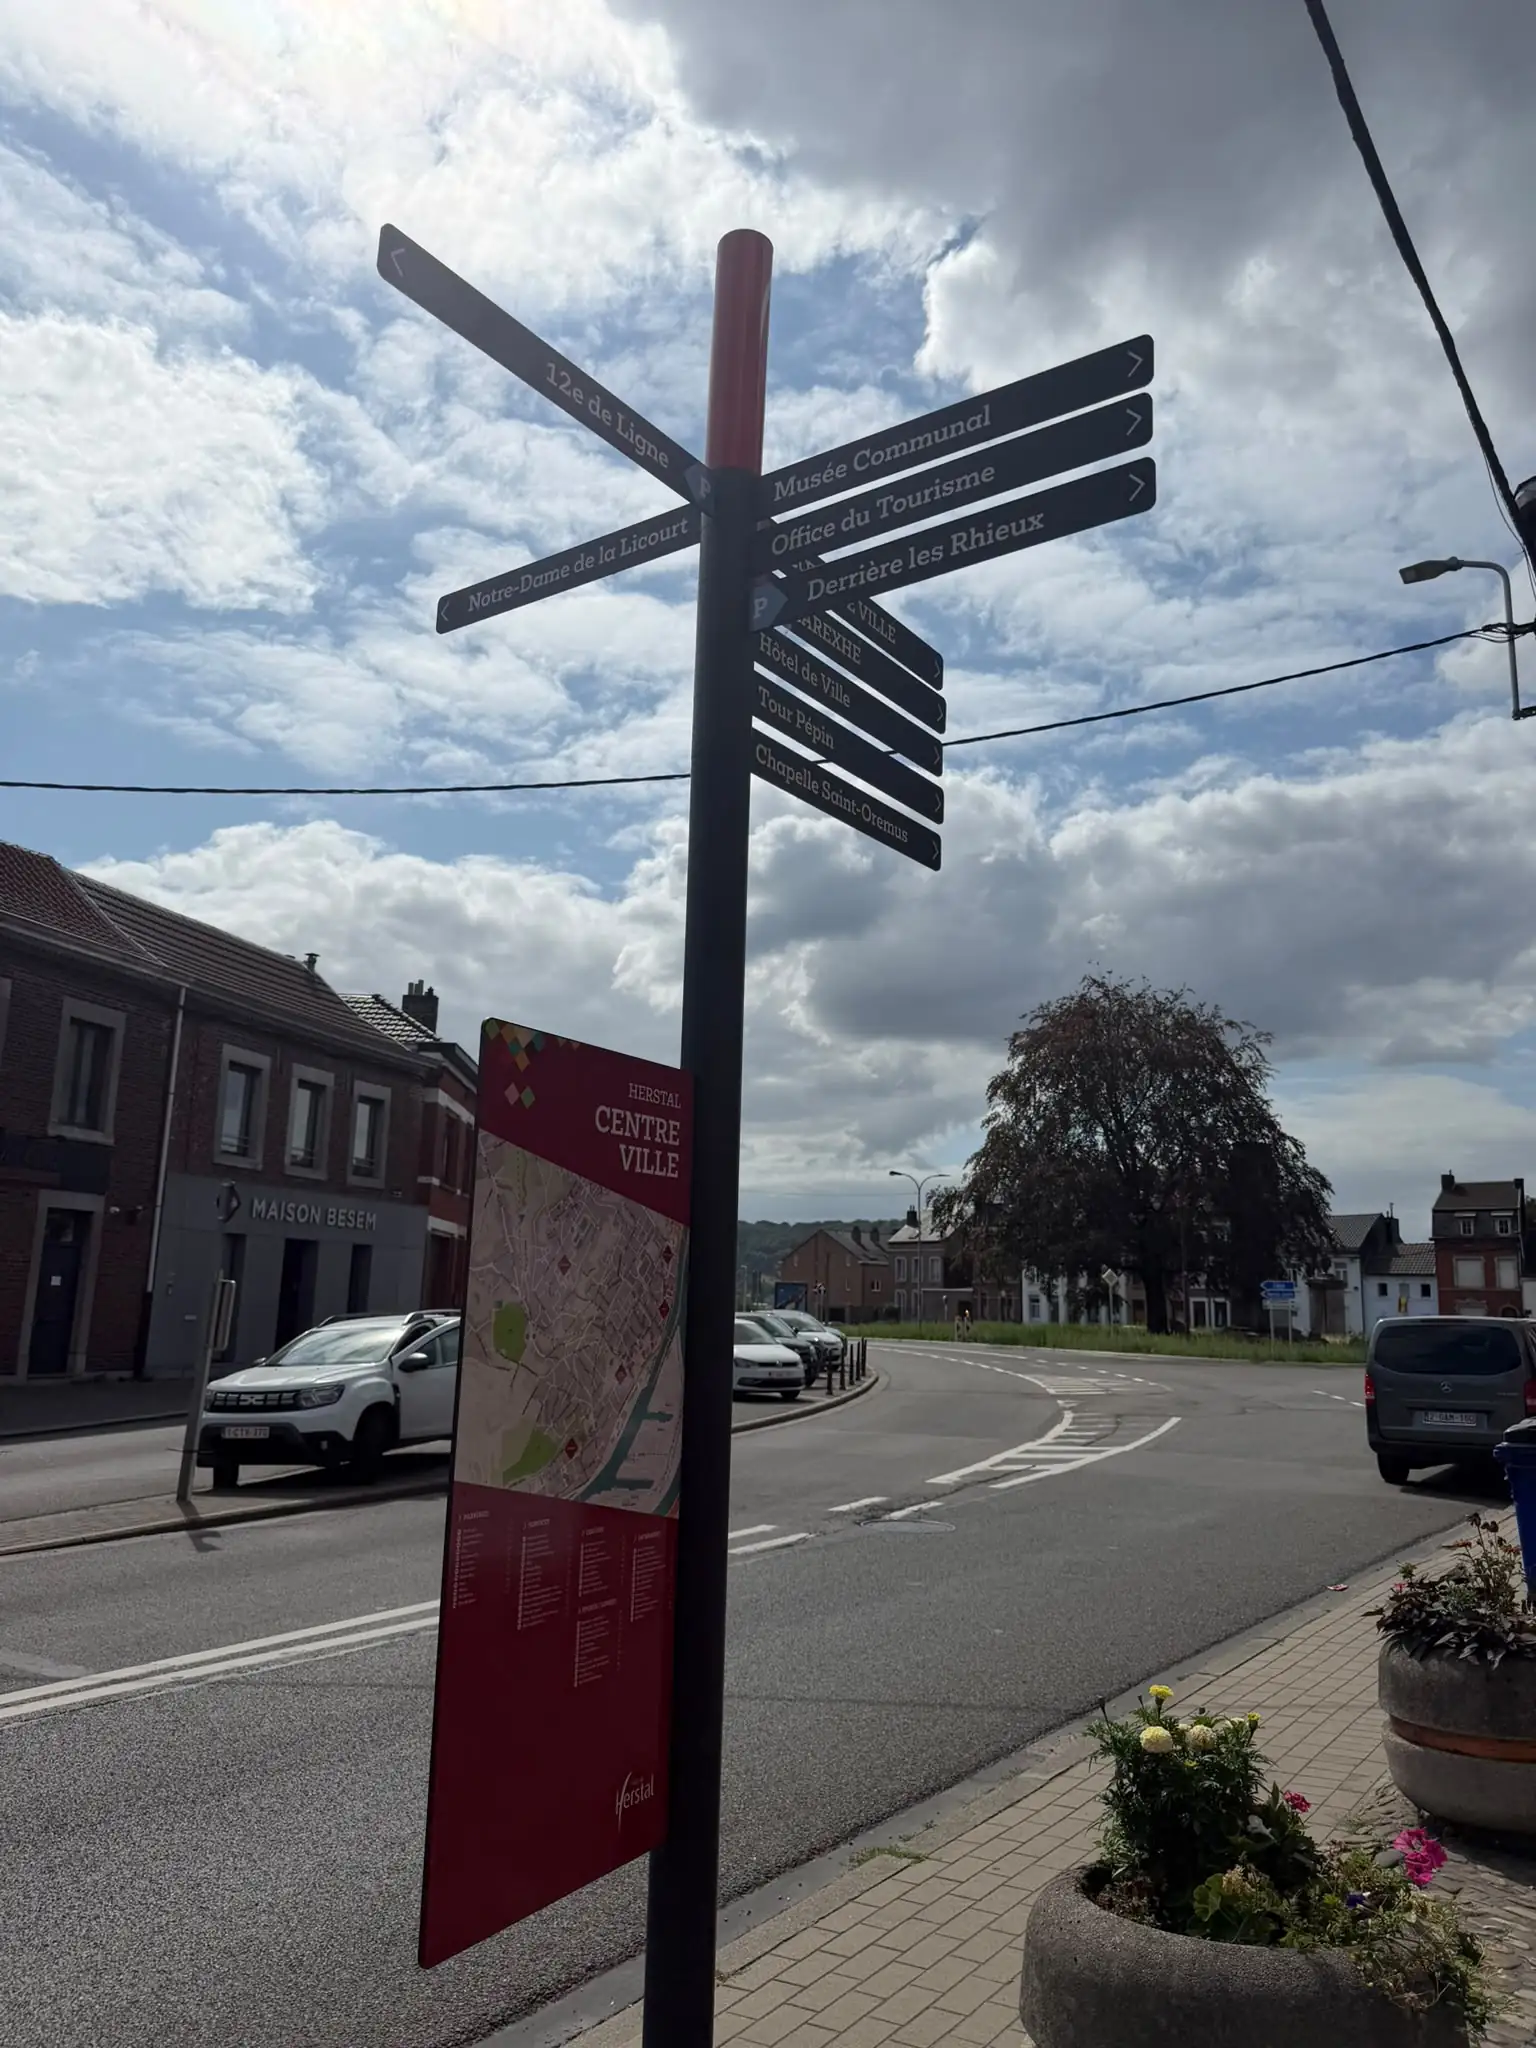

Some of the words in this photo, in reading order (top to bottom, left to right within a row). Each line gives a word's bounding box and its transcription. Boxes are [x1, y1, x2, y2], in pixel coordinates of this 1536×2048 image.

[545, 361, 584, 406] 12e
[588, 396, 612, 427] de
[616, 412, 668, 468] Ligne
[773, 461, 847, 501] Musée
[853, 405, 992, 472] Communal
[771, 522, 835, 556] Office
[841, 510, 870, 533] du
[876, 466, 995, 519] Tourisme
[468, 562, 570, 613] Notre-Dame
[574, 552, 596, 573] de
[599, 545, 617, 566] la
[620, 518, 689, 555] Licourt
[807, 557, 904, 602] Derrière
[908, 542, 944, 570] les
[950, 511, 1045, 557] Rhieux
[753, 597, 768, 619] P
[857, 600, 896, 645] VILLE
[760, 632, 799, 675] Hôtel
[801, 664, 819, 687] de
[820, 673, 850, 708] Ville
[797, 615, 862, 665] AREXHE
[758, 686, 793, 723] Tour
[795, 712, 835, 750] Pépin
[756, 744, 819, 794] Chapelle
[821, 781, 909, 843] Saint-Oremus
[594, 1104, 681, 1146] CENTRE
[628, 1082, 682, 1109] HERSTAL
[618, 1143, 680, 1179] VILLE
[252, 1197, 321, 1225] MAISON
[327, 1207, 377, 1231] BESEM
[615, 1771, 655, 1834] Herstal
